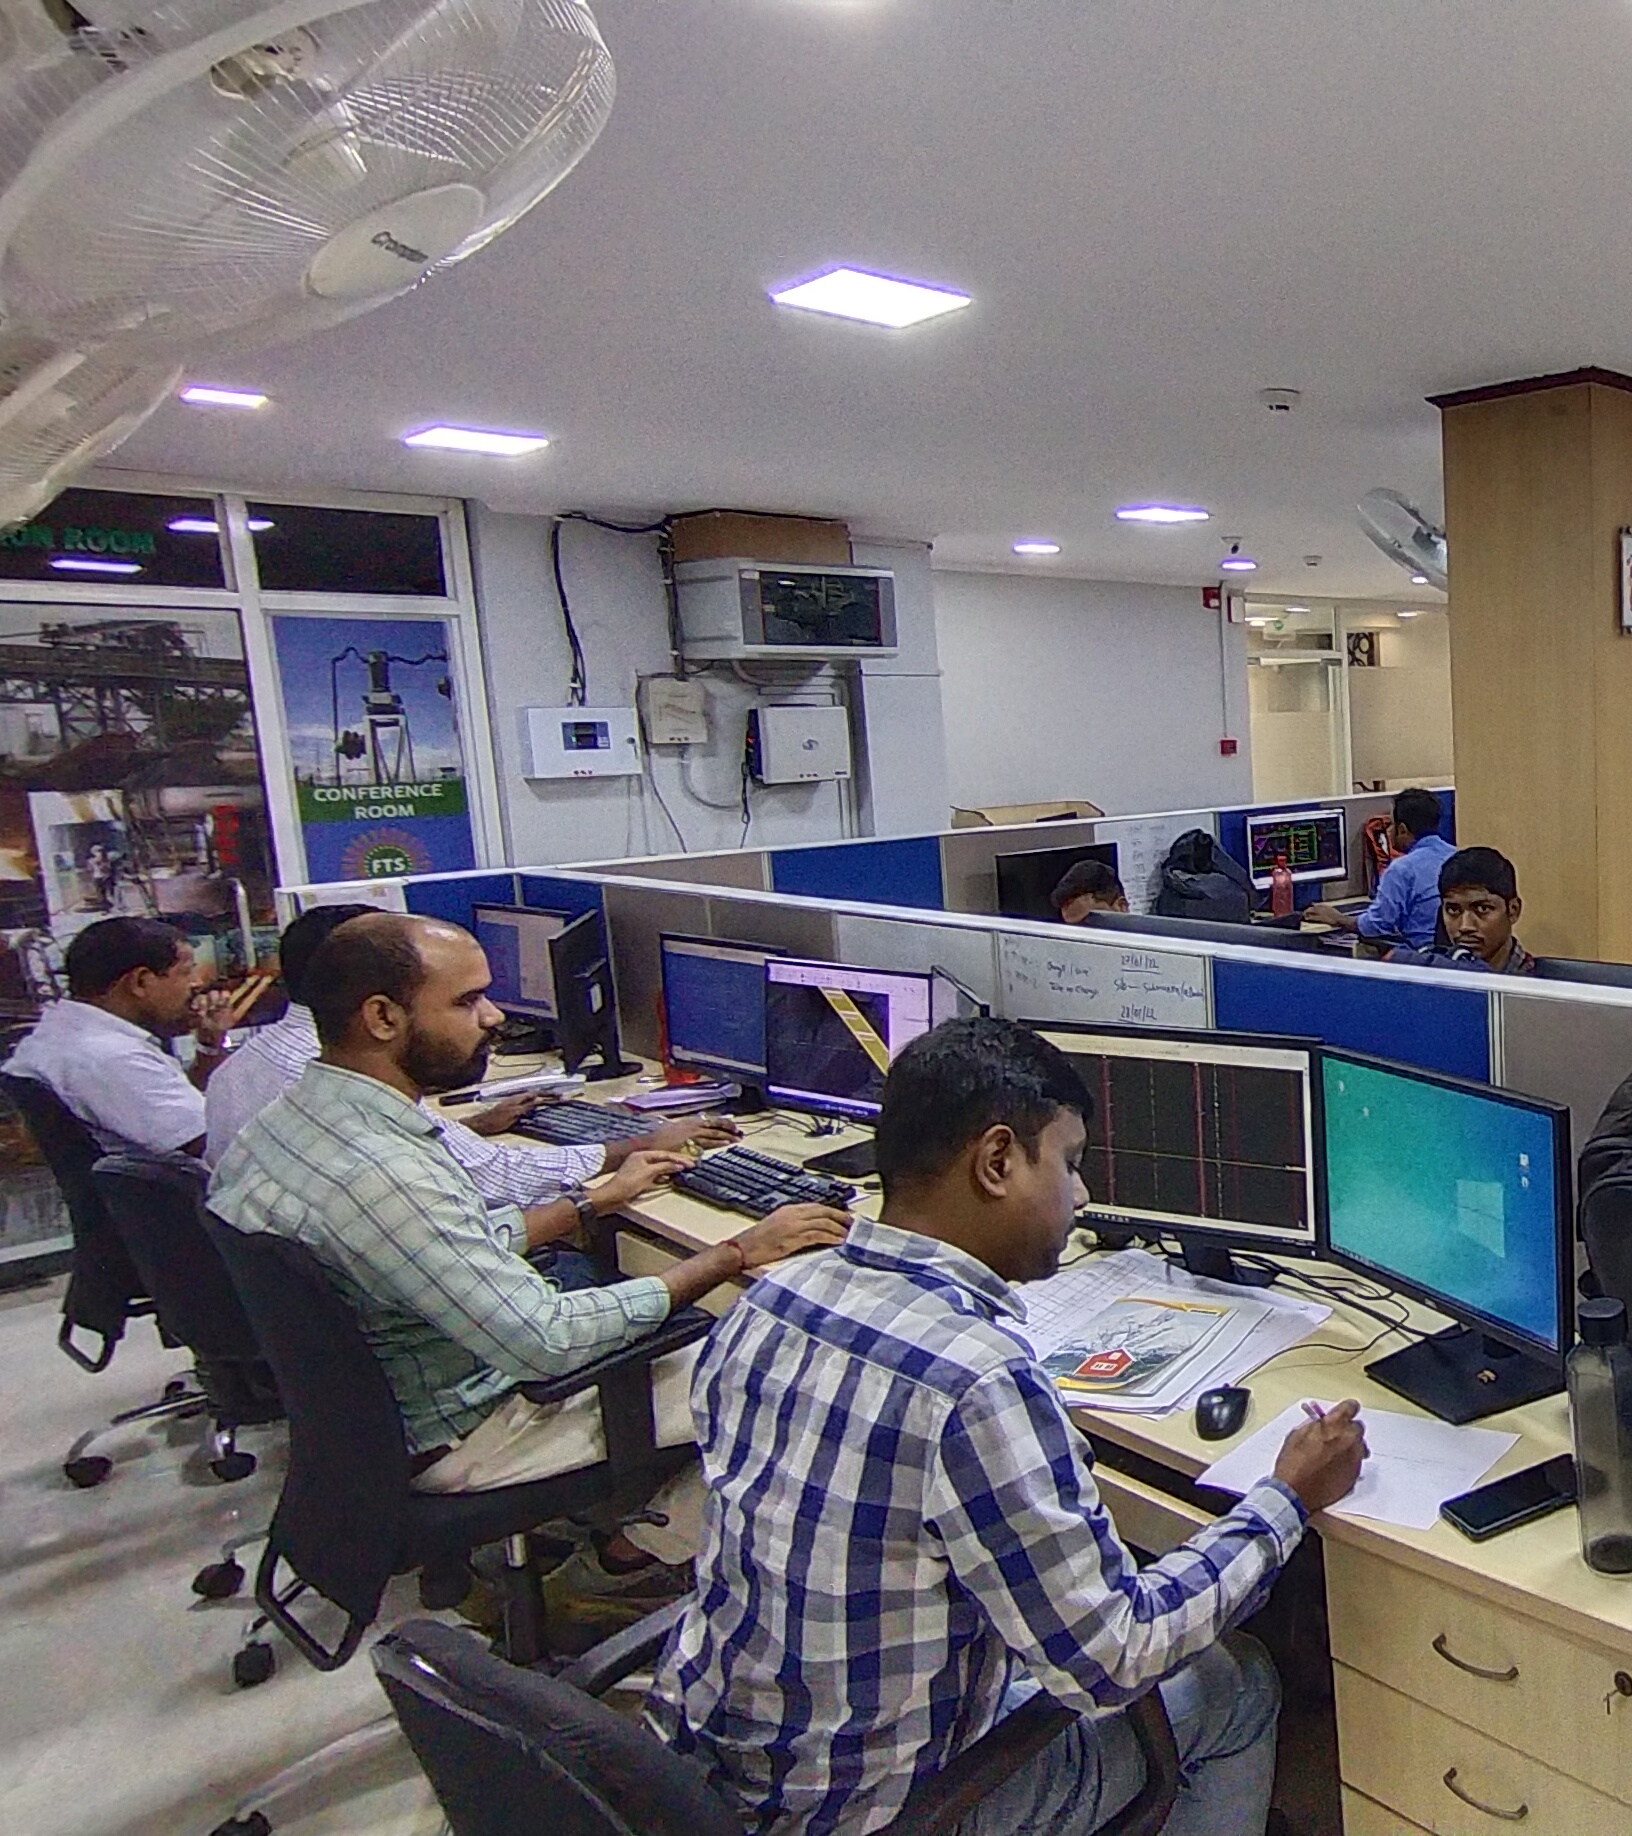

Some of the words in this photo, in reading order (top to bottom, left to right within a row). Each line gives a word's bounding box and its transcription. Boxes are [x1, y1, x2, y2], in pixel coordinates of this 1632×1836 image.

[313, 783, 443, 801] CONFERENCE
[354, 803, 415, 820] ROOM
[372, 857, 406, 874] FTS
